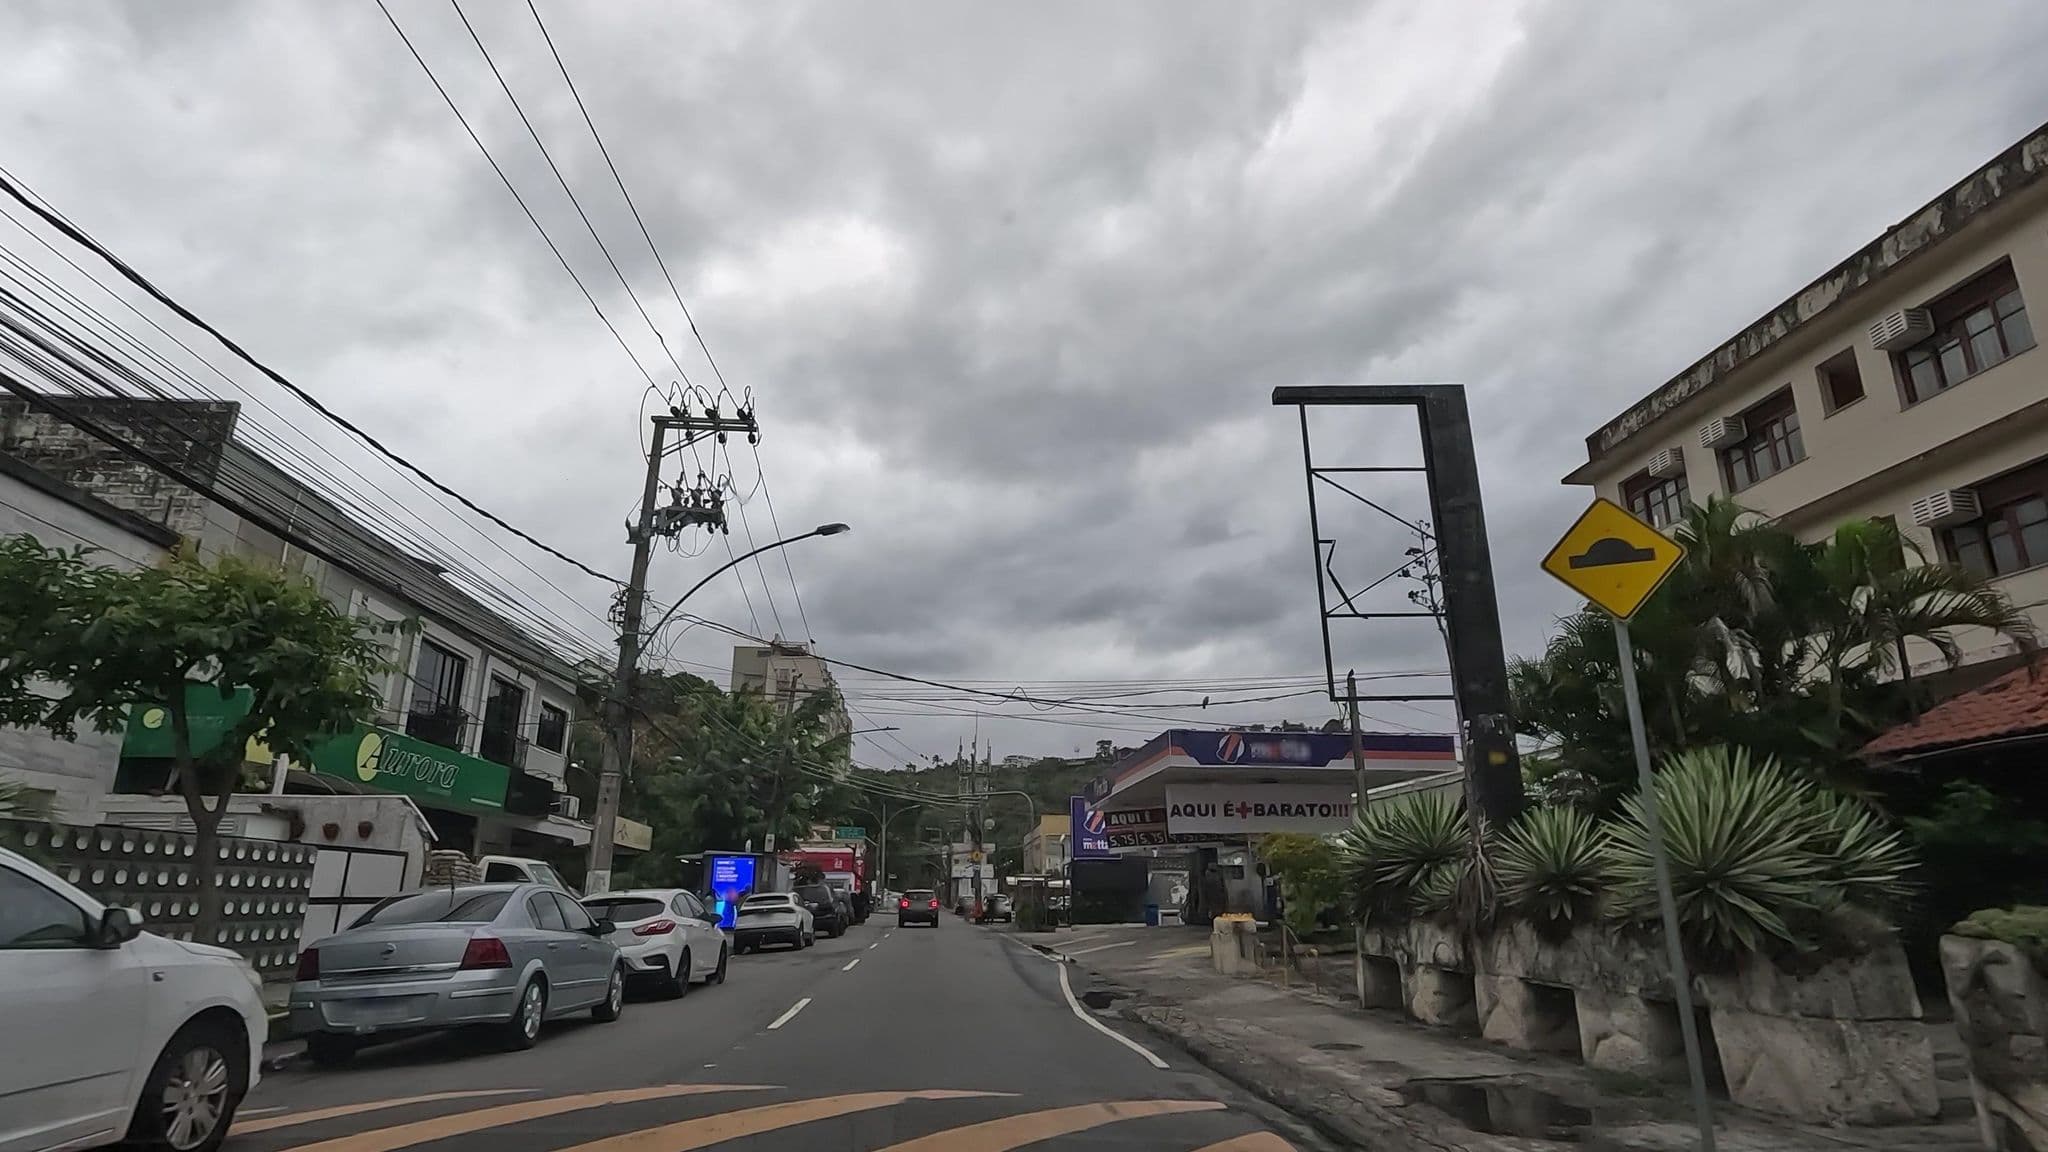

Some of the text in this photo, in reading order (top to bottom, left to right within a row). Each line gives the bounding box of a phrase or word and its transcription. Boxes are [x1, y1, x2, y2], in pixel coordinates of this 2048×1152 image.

[360, 734, 460, 788] Aurora
[1170, 803, 1216, 818] AQUI
[1111, 813, 1141, 825] AQUI
